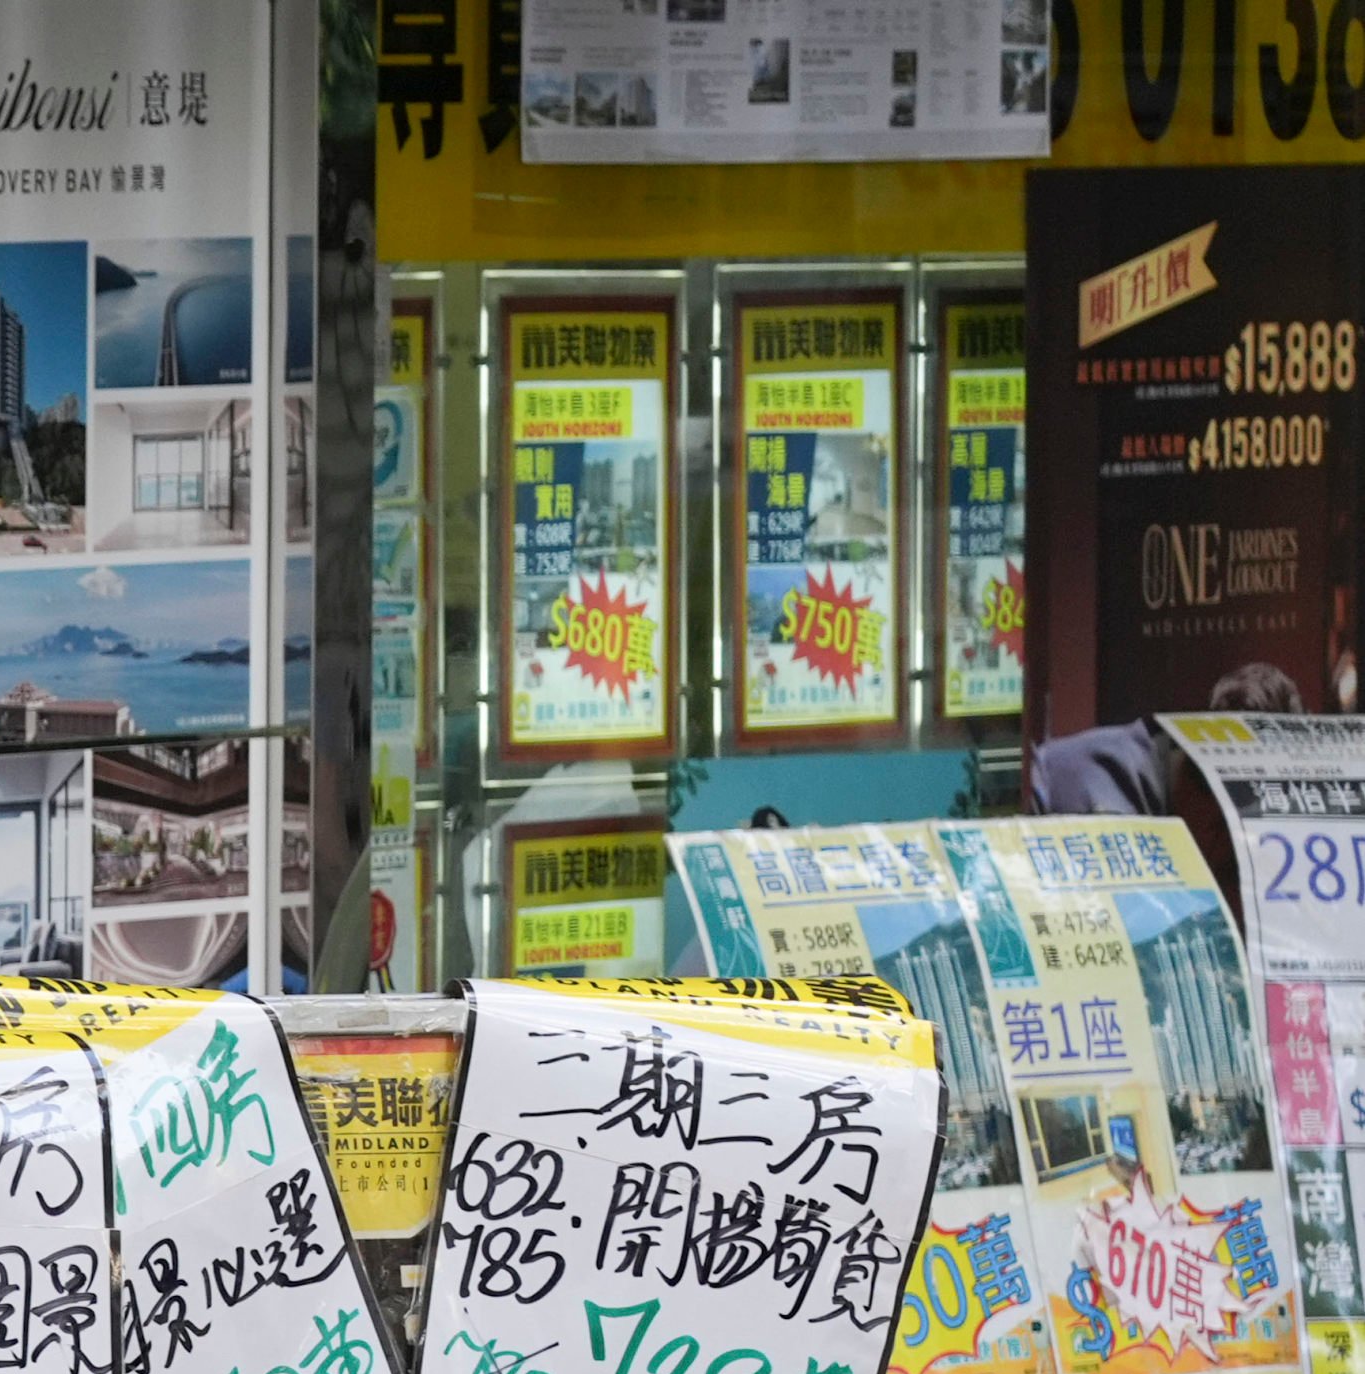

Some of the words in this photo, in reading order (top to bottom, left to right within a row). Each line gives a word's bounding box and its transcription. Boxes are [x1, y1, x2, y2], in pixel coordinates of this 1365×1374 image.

[66, 167, 102, 193] BAY
[1142, 522, 1222, 611] ONE
[548, 590, 660, 681] $680萬
[779, 586, 887, 672] $750萬
[740, 1002, 903, 1050] REALTY
[1003, 996, 1128, 1065] 第1座
[334, 1137, 430, 1150] MIDLAND
[336, 1158, 422, 1169] Founded
[1107, 1219, 1208, 1334] 670萬
